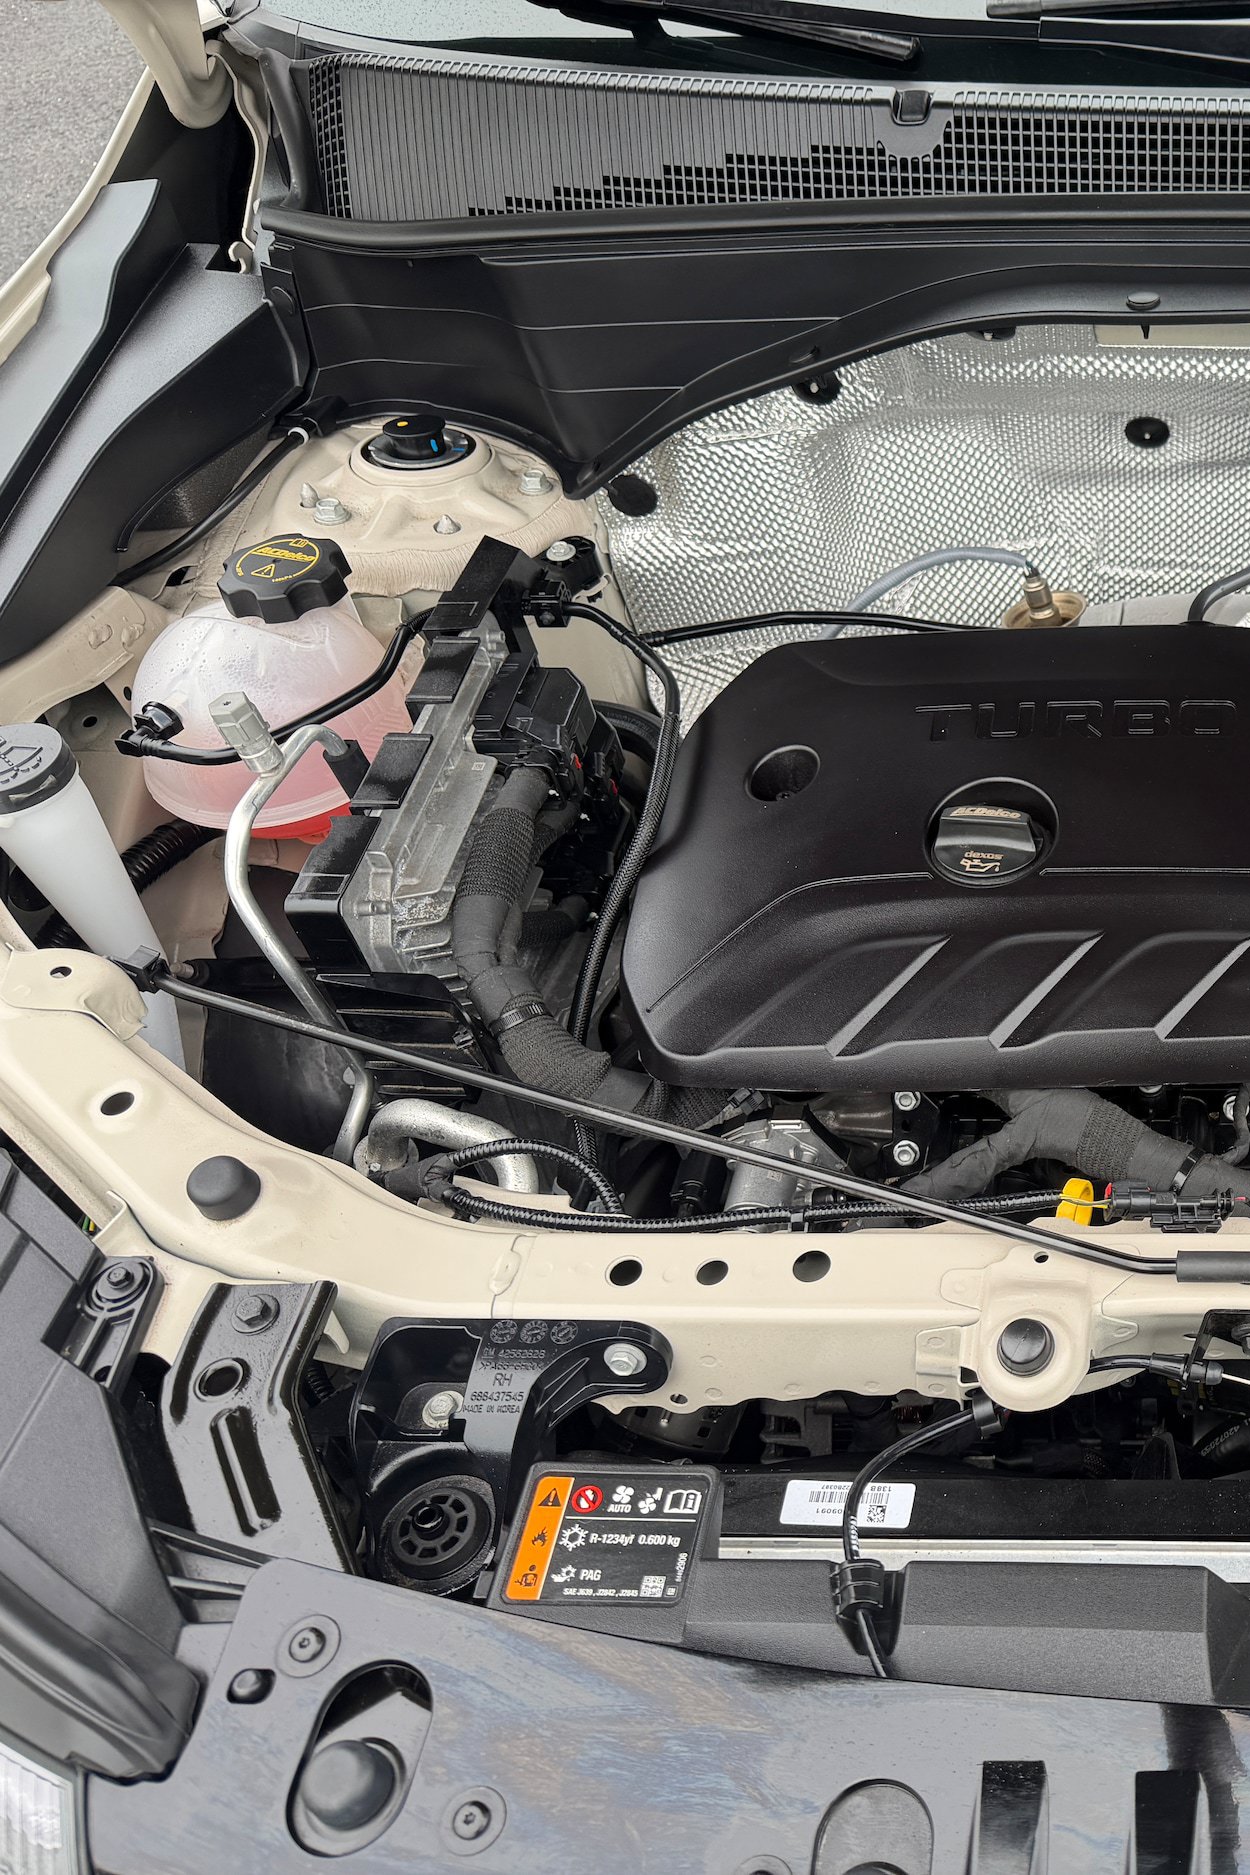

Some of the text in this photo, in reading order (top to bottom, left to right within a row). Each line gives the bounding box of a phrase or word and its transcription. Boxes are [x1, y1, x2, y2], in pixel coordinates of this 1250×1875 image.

[915, 700, 1237, 742] TURBO
[950, 807, 1021, 819] ACDelco
[964, 850, 1004, 860] dexos
[493, 1372, 513, 1386] RH
[463, 1404, 520, 1413] MADE IN KOREA
[607, 1504, 632, 1513] AUTO
[589, 1534, 681, 1547] R-1234yf 0.600 kg
[579, 1569, 602, 1581] PAG
[563, 1588, 577, 1596] SAE
